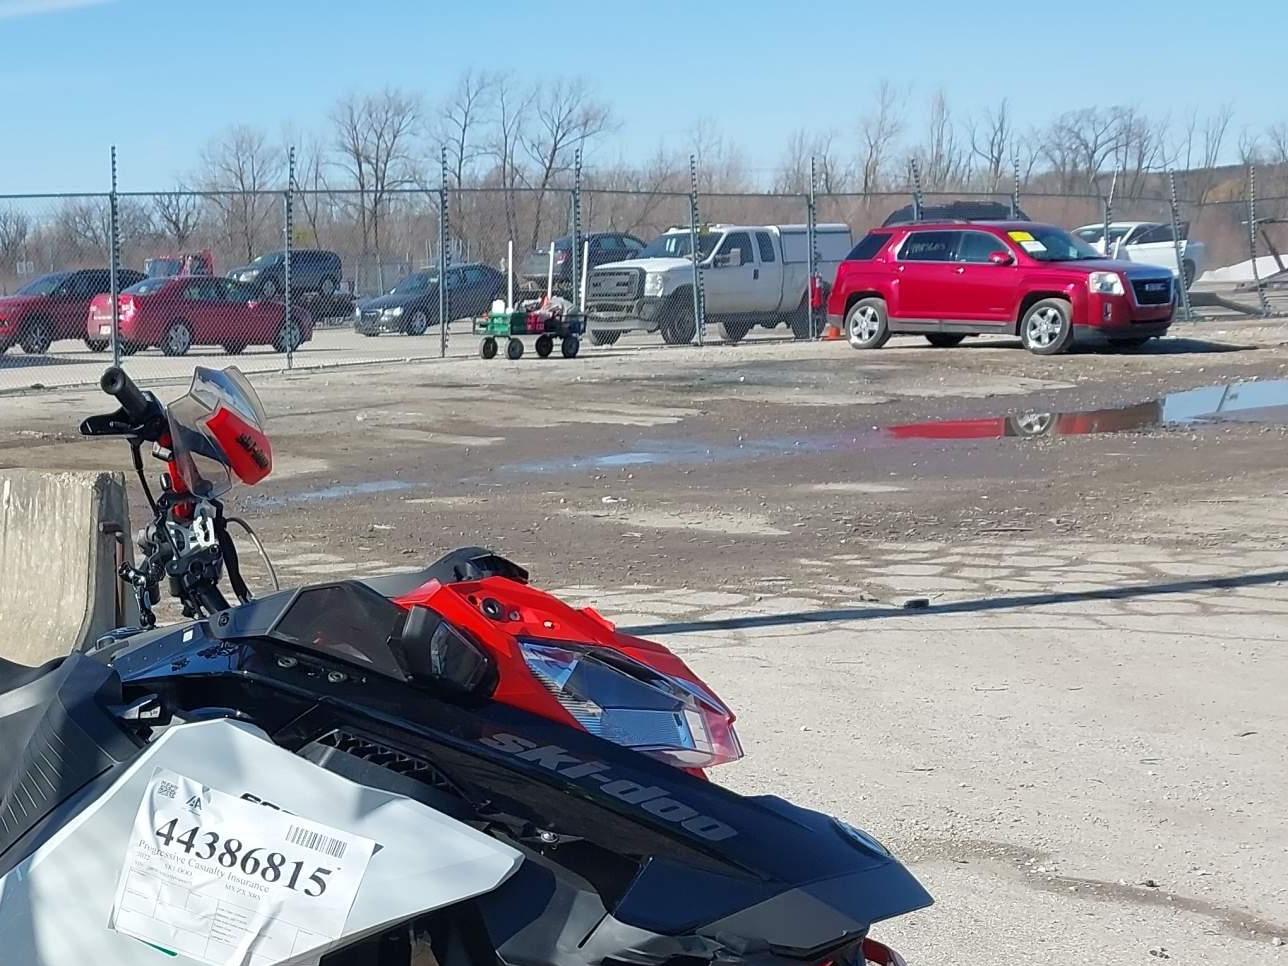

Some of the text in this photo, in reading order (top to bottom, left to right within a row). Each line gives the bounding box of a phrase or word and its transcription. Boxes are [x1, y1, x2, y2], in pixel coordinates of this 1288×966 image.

[139, 839, 187, 865] Progressive
[188, 857, 225, 878] Casualty
[227, 871, 270, 893] Insurance
[155, 817, 334, 897] 44386815
